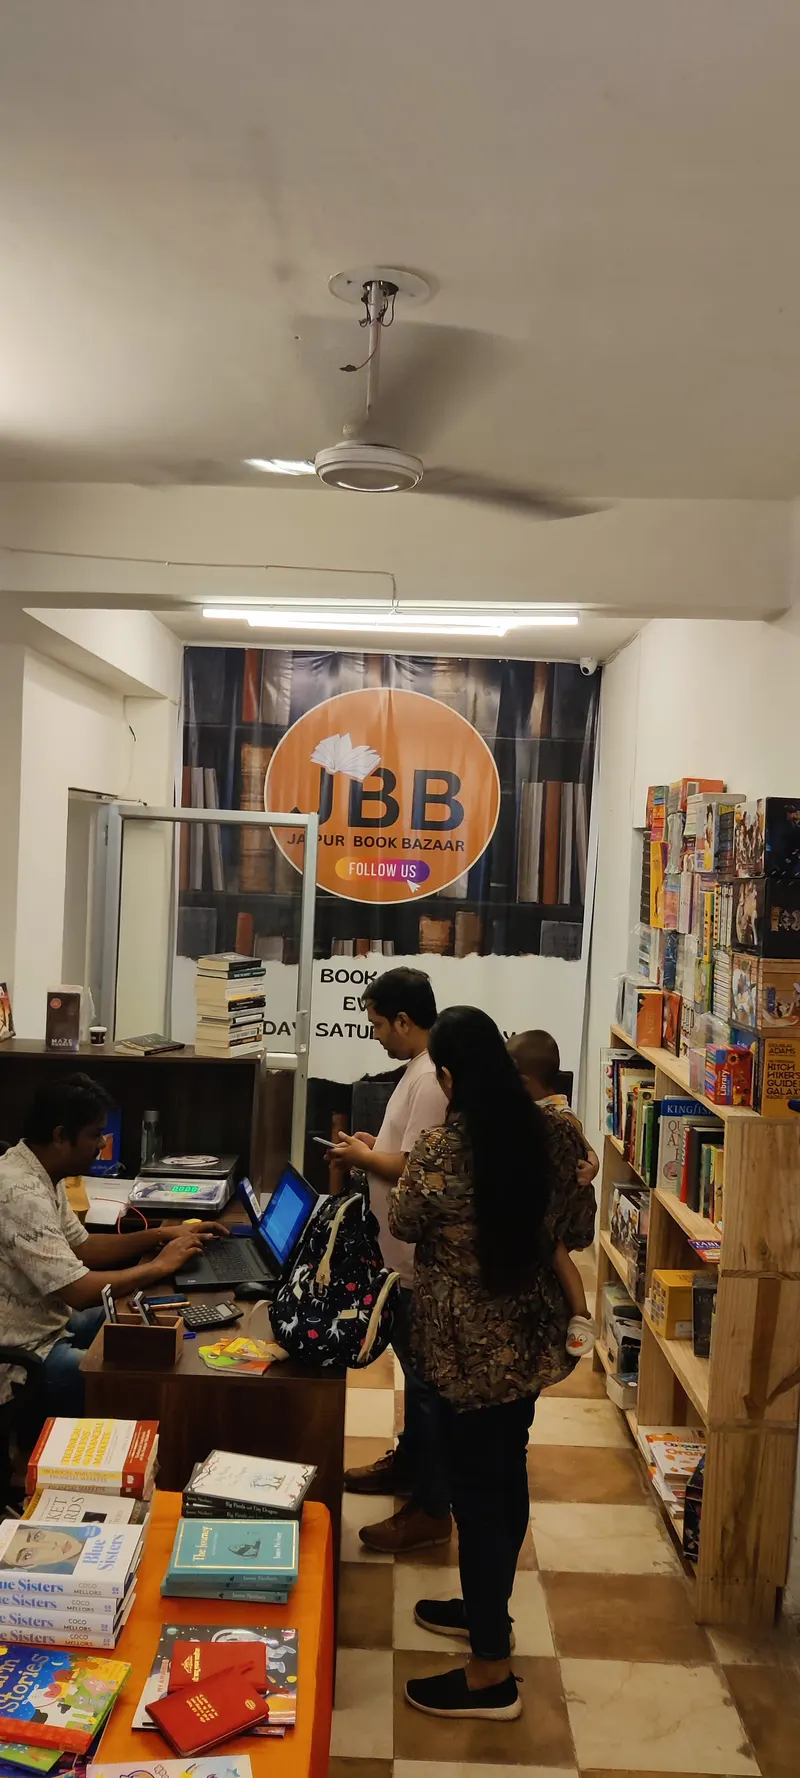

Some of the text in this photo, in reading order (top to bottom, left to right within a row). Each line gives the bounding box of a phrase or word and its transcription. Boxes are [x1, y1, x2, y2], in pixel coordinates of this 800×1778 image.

[289, 767, 465, 832] JBB
[287, 833, 465, 851] JAPUR BOOK BAZAAR
[349, 862, 416, 878] FOLLOW US
[767, 1063, 796, 1071] HITCH
[720, 1070, 731, 1096] Library
[767, 1080, 798, 1088] GUIDE
[766, 1087, 800, 1096] GALAX
[82, 1539, 106, 1564] Blue
[192, 1526, 213, 1562] The Journey
[97, 1534, 124, 1571] Sisters
[18, 1579, 64, 1593] Sisters
[12, 1593, 57, 1609] Sisters
[66, 1605, 95, 1613] MELLORS
[9, 1612, 54, 1628] Sisters
[63, 1624, 92, 1632] MELLORS
[10, 1629, 56, 1644] Sisters
[0, 1653, 50, 1713] Stories
